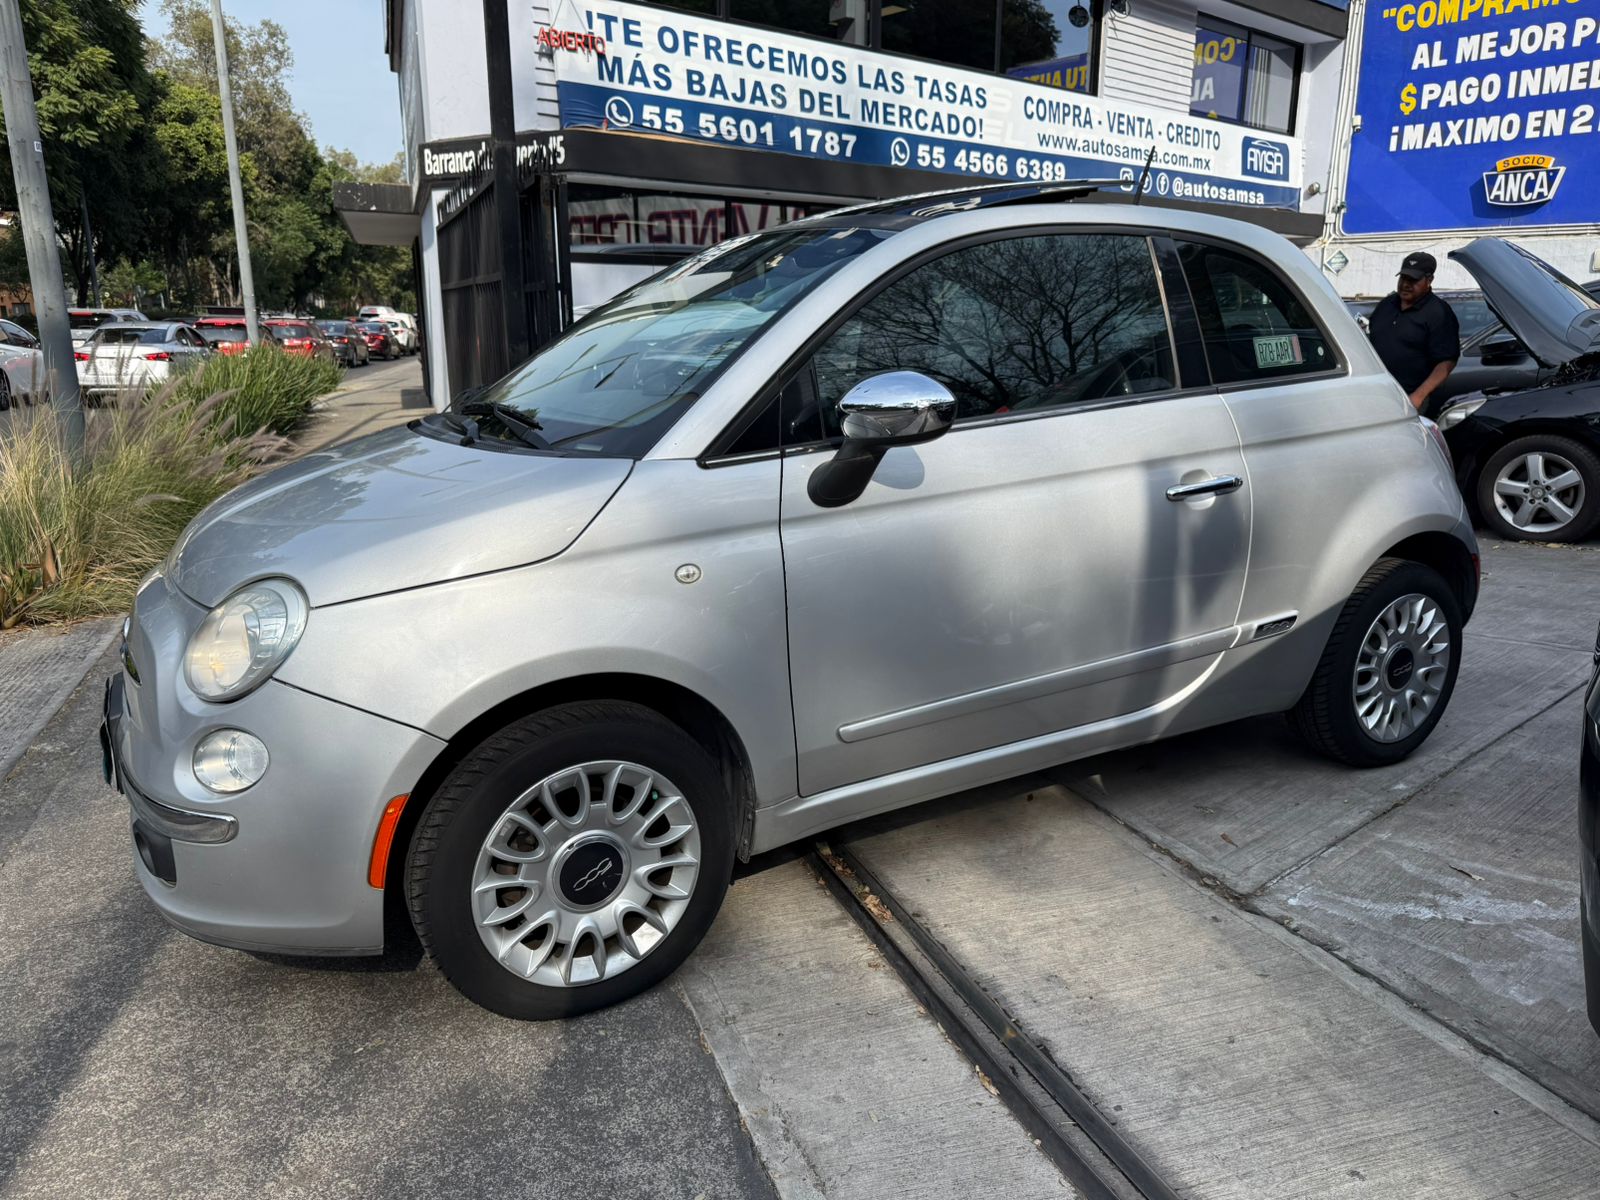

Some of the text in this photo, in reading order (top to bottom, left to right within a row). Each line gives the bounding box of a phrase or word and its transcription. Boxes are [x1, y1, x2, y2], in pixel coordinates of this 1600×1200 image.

[537, 26, 606, 55] ABIERTO
[1411, 41, 1448, 70] AL
[1455, 22, 1567, 64] MEJOR
[657, 26, 847, 85] OFRECEMOS
[857, 64, 905, 95] LAS
[914, 75, 988, 109] TASAS
[597, 53, 984, 140] MÁS BAJAS DEL MERCADO!
[642, 104, 857, 158] 55 5601 1787
[1024, 96, 1093, 129] COMPRA
[1107, 111, 1154, 140] VENTA
[1166, 122, 1221, 150] CREDITO
[1389, 104, 1595, 152] ¡MAXIMO EN 2
[423, 148, 475, 176] Barranca
[916, 144, 1067, 181] 55 4566 6389
[1037, 133, 1211, 171] www.autosamsa.com.mx
[1502, 156, 1546, 168] SOCIO
[1172, 176, 1265, 205] @autosamsa
[1489, 171, 1549, 202] ANCA
